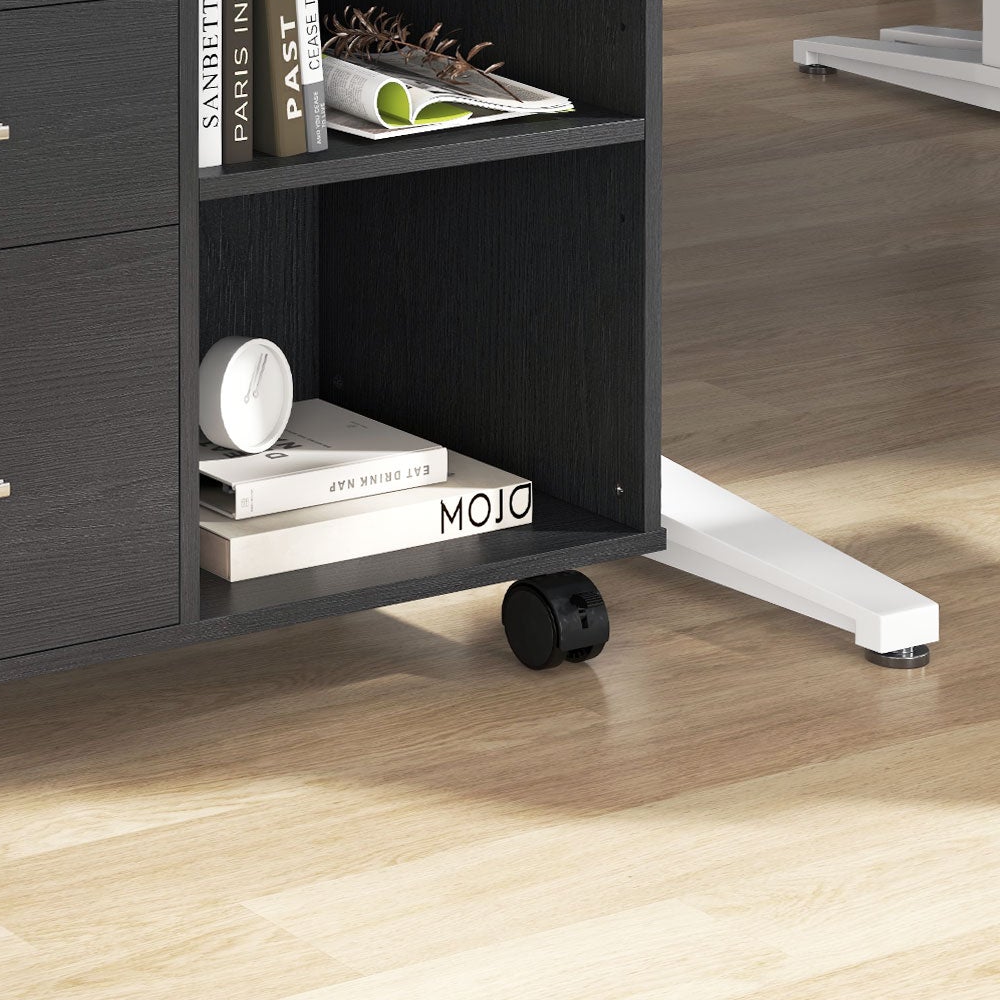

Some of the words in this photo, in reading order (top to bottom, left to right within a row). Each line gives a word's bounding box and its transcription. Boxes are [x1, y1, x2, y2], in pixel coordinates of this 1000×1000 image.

[280, 15, 303, 121] PAST
[305, 15, 320, 71] CEASE
[234, 46, 248, 143] PARIS
[329, 477, 356, 493] NAP
[359, 468, 401, 487] DRINK
[406, 464, 430, 479] EAT
[440, 482, 532, 534] MOJO
